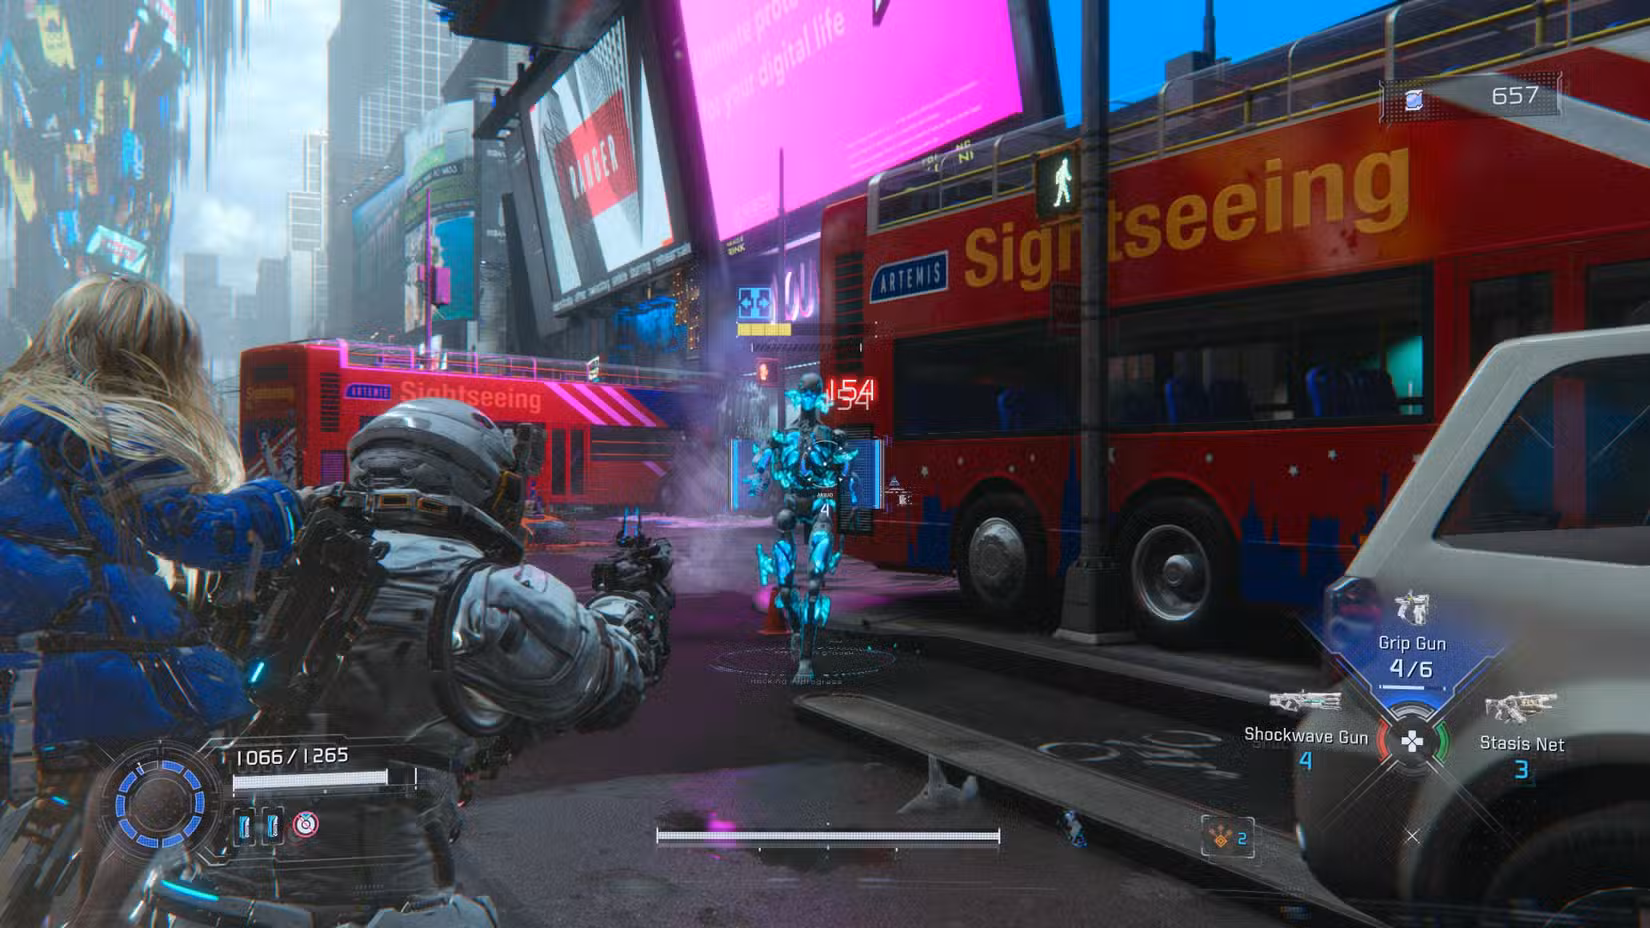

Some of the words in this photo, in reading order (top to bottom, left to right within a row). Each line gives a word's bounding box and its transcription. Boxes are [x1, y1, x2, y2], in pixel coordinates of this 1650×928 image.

[758, 23, 813, 87] digital
[813, 6, 846, 52] life
[880, 263, 943, 295] ARTEMIS
[401, 381, 541, 413] Sightseeing
